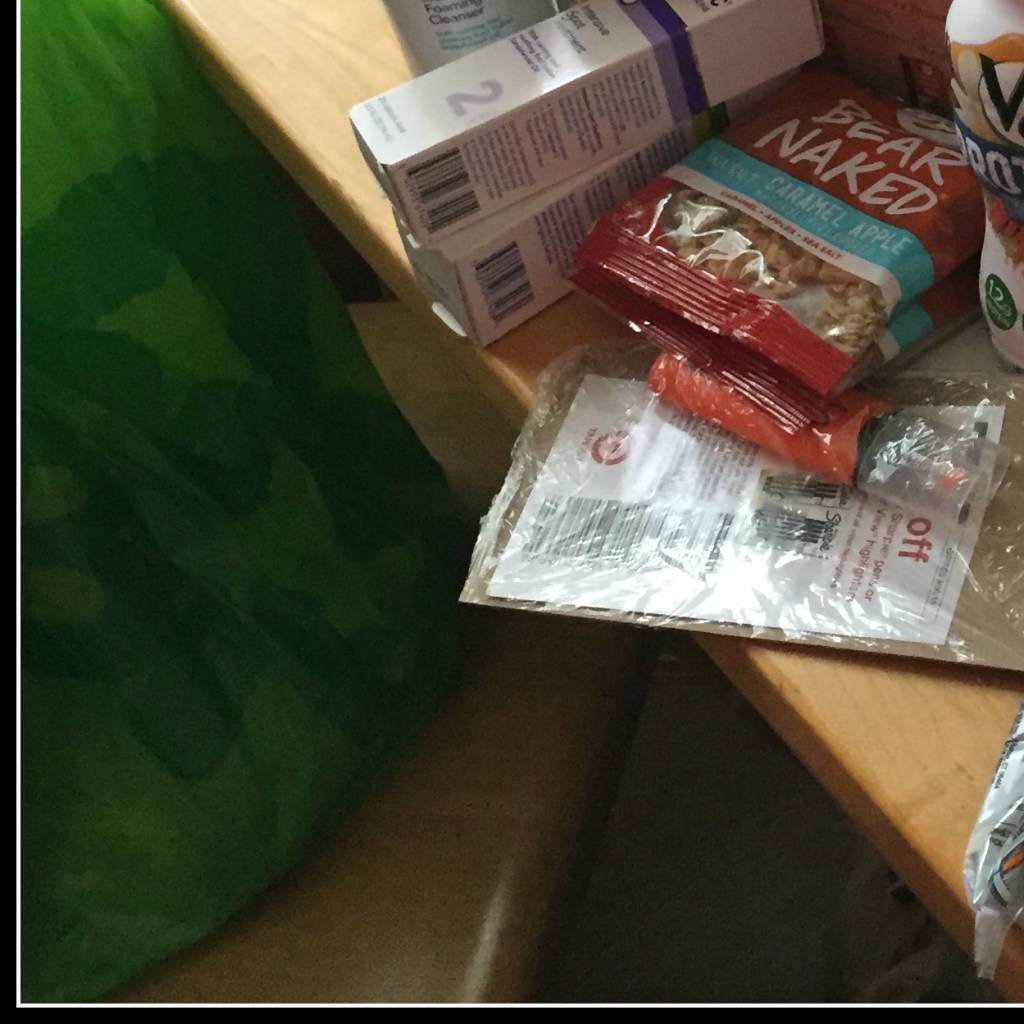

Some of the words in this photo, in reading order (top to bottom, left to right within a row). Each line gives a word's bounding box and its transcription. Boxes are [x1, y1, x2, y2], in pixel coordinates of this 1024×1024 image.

[429, 7, 484, 26] Cleanser
[446, 80, 504, 118] 2
[754, 118, 938, 216] NAKED
[812, 98, 970, 186] BEAR
[764, 176, 848, 228] CARAMEL
[849, 222, 914, 255] APPLE
[802, 235, 820, 250] SEA
[819, 243, 843, 261] SALT
